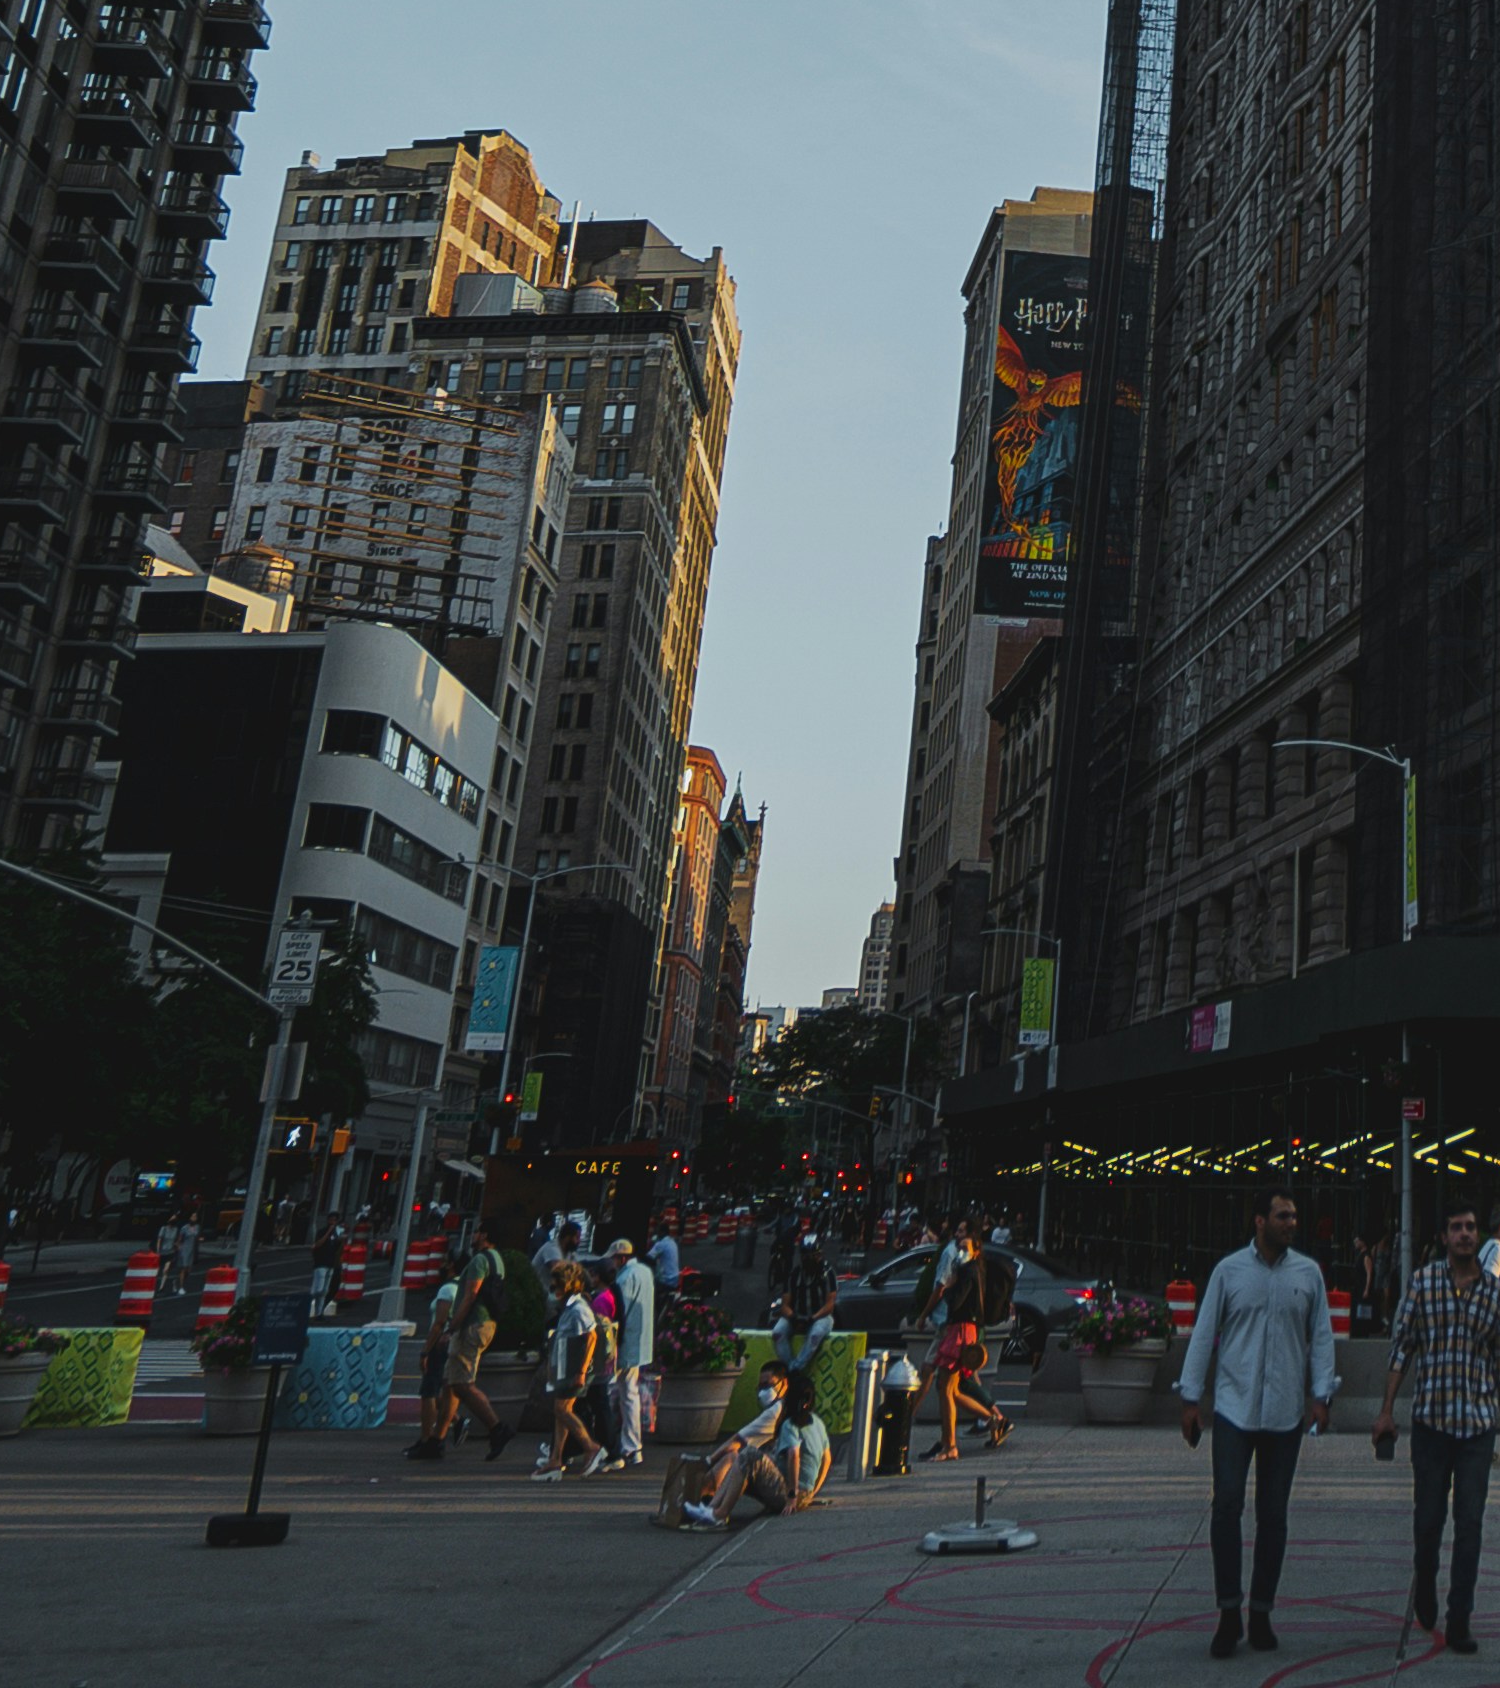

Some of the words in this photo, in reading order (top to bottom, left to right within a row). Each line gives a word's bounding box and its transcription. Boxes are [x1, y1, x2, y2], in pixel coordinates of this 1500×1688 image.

[1013, 297, 1073, 334] Harry
[1051, 341, 1071, 350] NEW
[1010, 562, 1029, 571] THE
[1031, 564, 1068, 574] OFFICIA
[1012, 571, 1024, 579] AT
[1028, 590, 1051, 599] NOW
[290, 933, 311, 941] CITY
[285, 941, 312, 950] SPEED
[285, 950, 309, 958] LIMIT
[276, 959, 313, 981] 25
[575, 1160, 623, 1175] CAFE
[268, 1352, 298, 1361] smoking
